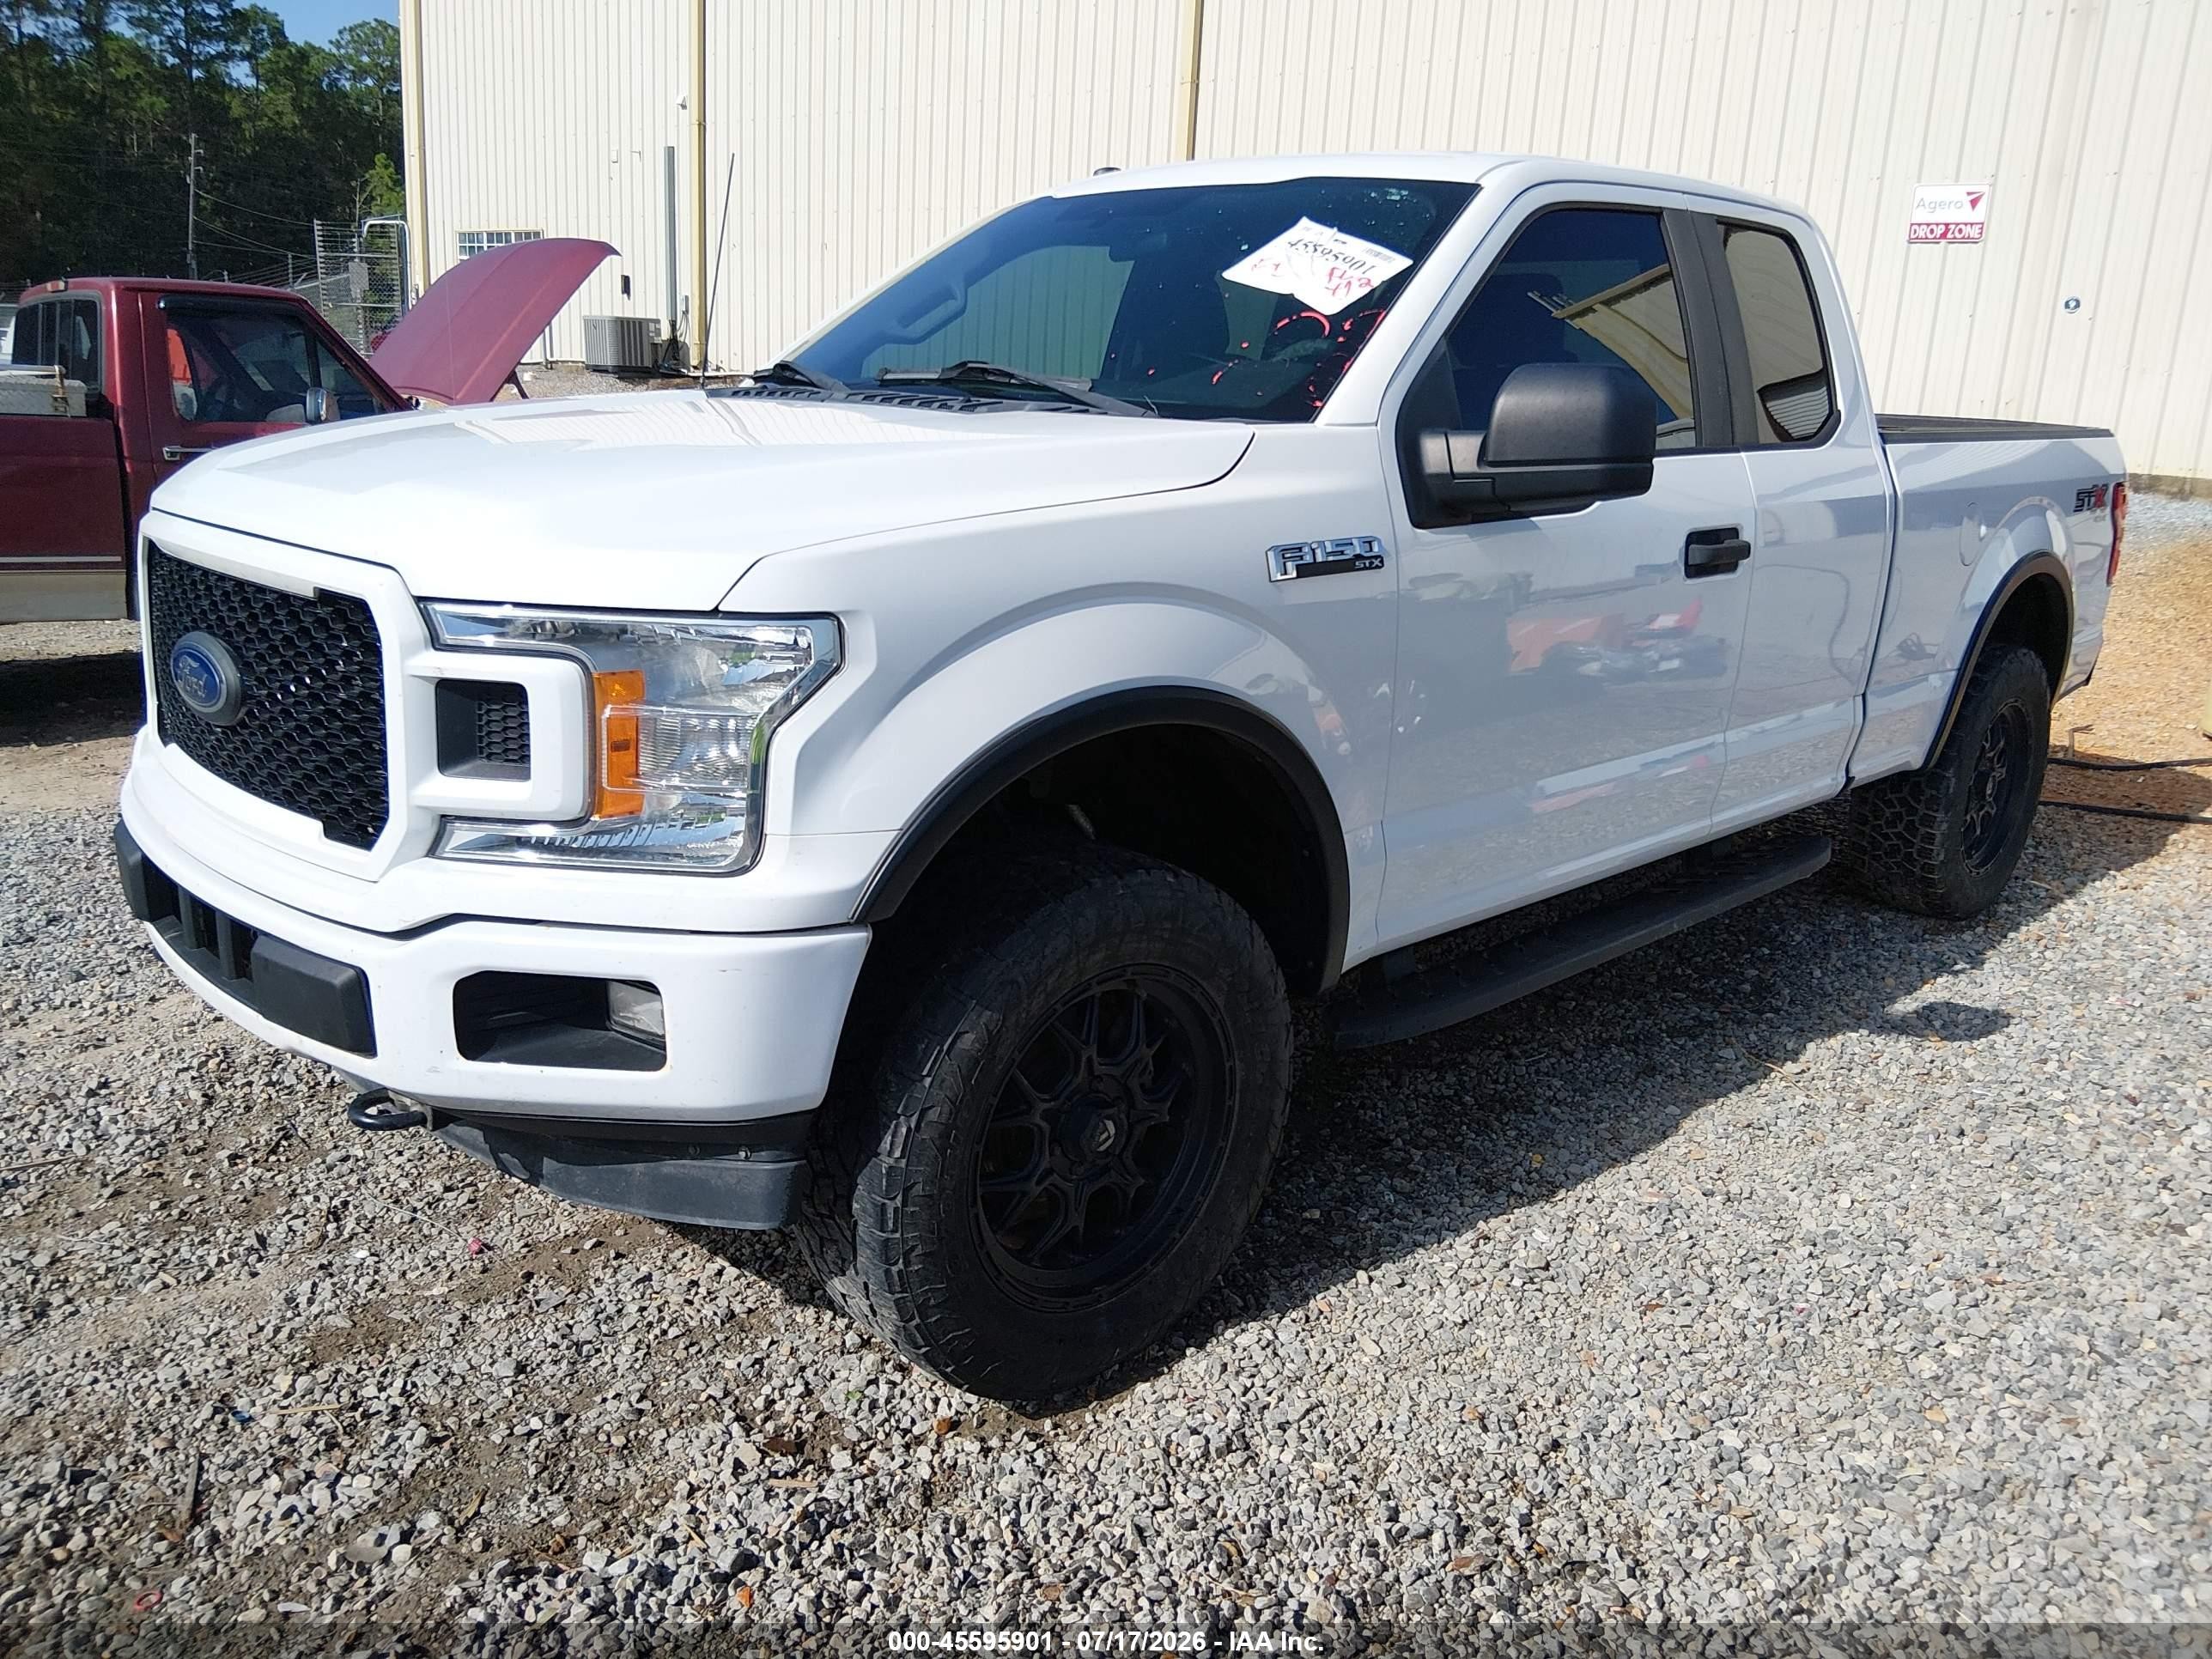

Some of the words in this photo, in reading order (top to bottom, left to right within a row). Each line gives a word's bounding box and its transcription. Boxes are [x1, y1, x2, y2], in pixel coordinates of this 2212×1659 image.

[1916, 198, 1964, 213] Agero
[1911, 224, 1946, 239] DROP
[1947, 223, 1984, 239] ZONE
[2073, 483, 2109, 513] STX
[1354, 558, 1382, 568] STX
